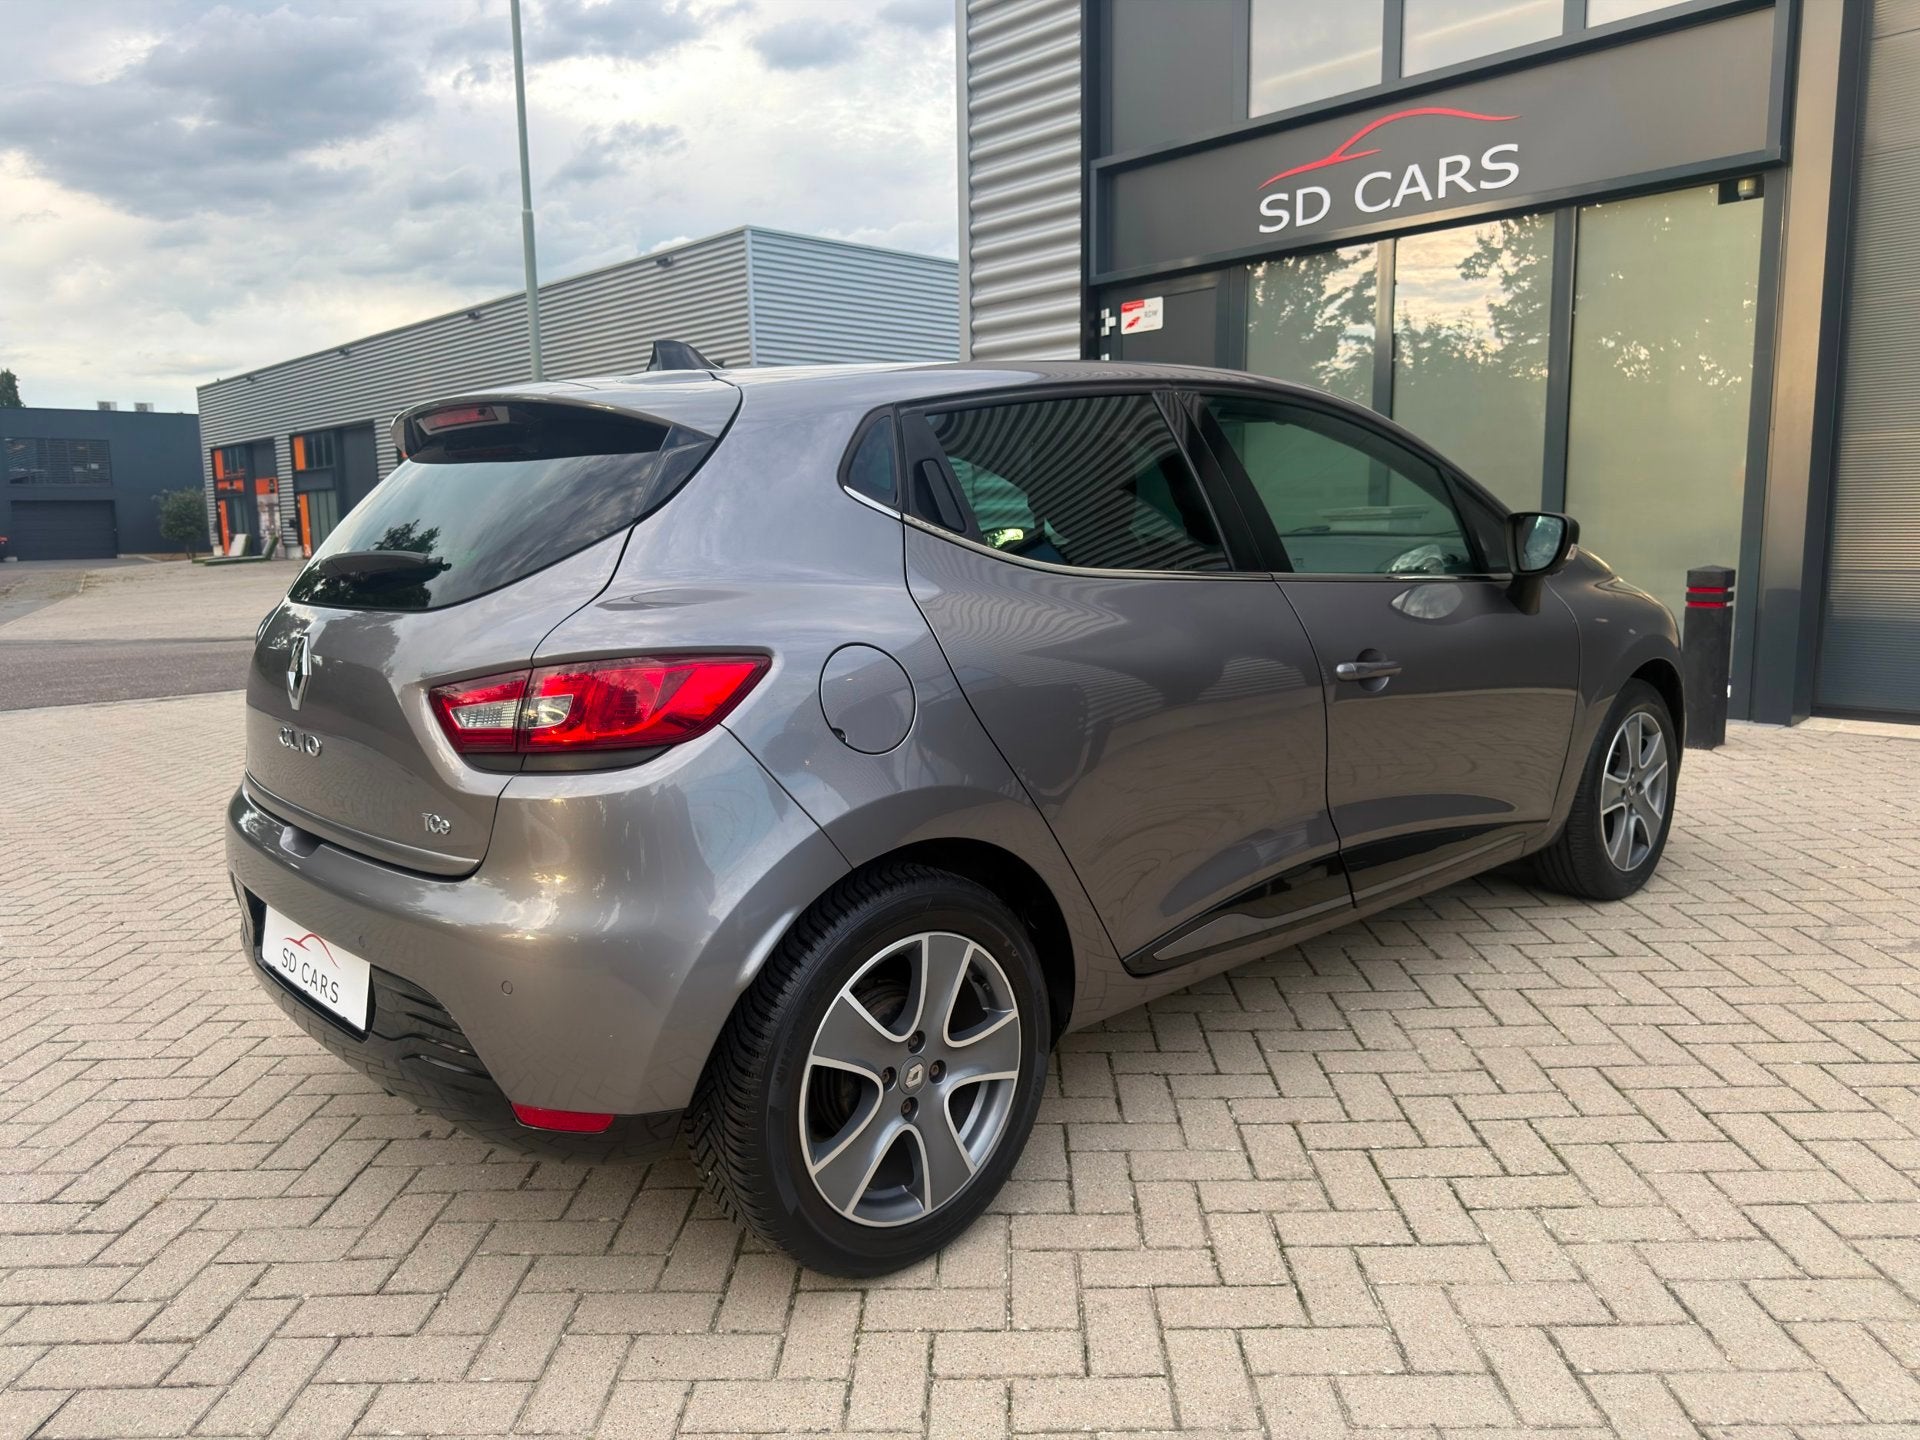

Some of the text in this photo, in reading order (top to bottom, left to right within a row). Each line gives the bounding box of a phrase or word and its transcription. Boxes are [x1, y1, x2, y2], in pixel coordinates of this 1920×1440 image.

[1258, 143, 1520, 233] SD CARS
[277, 726, 323, 757] CLIO
[421, 812, 452, 835] TCe
[281, 947, 340, 1004] SD CARS
